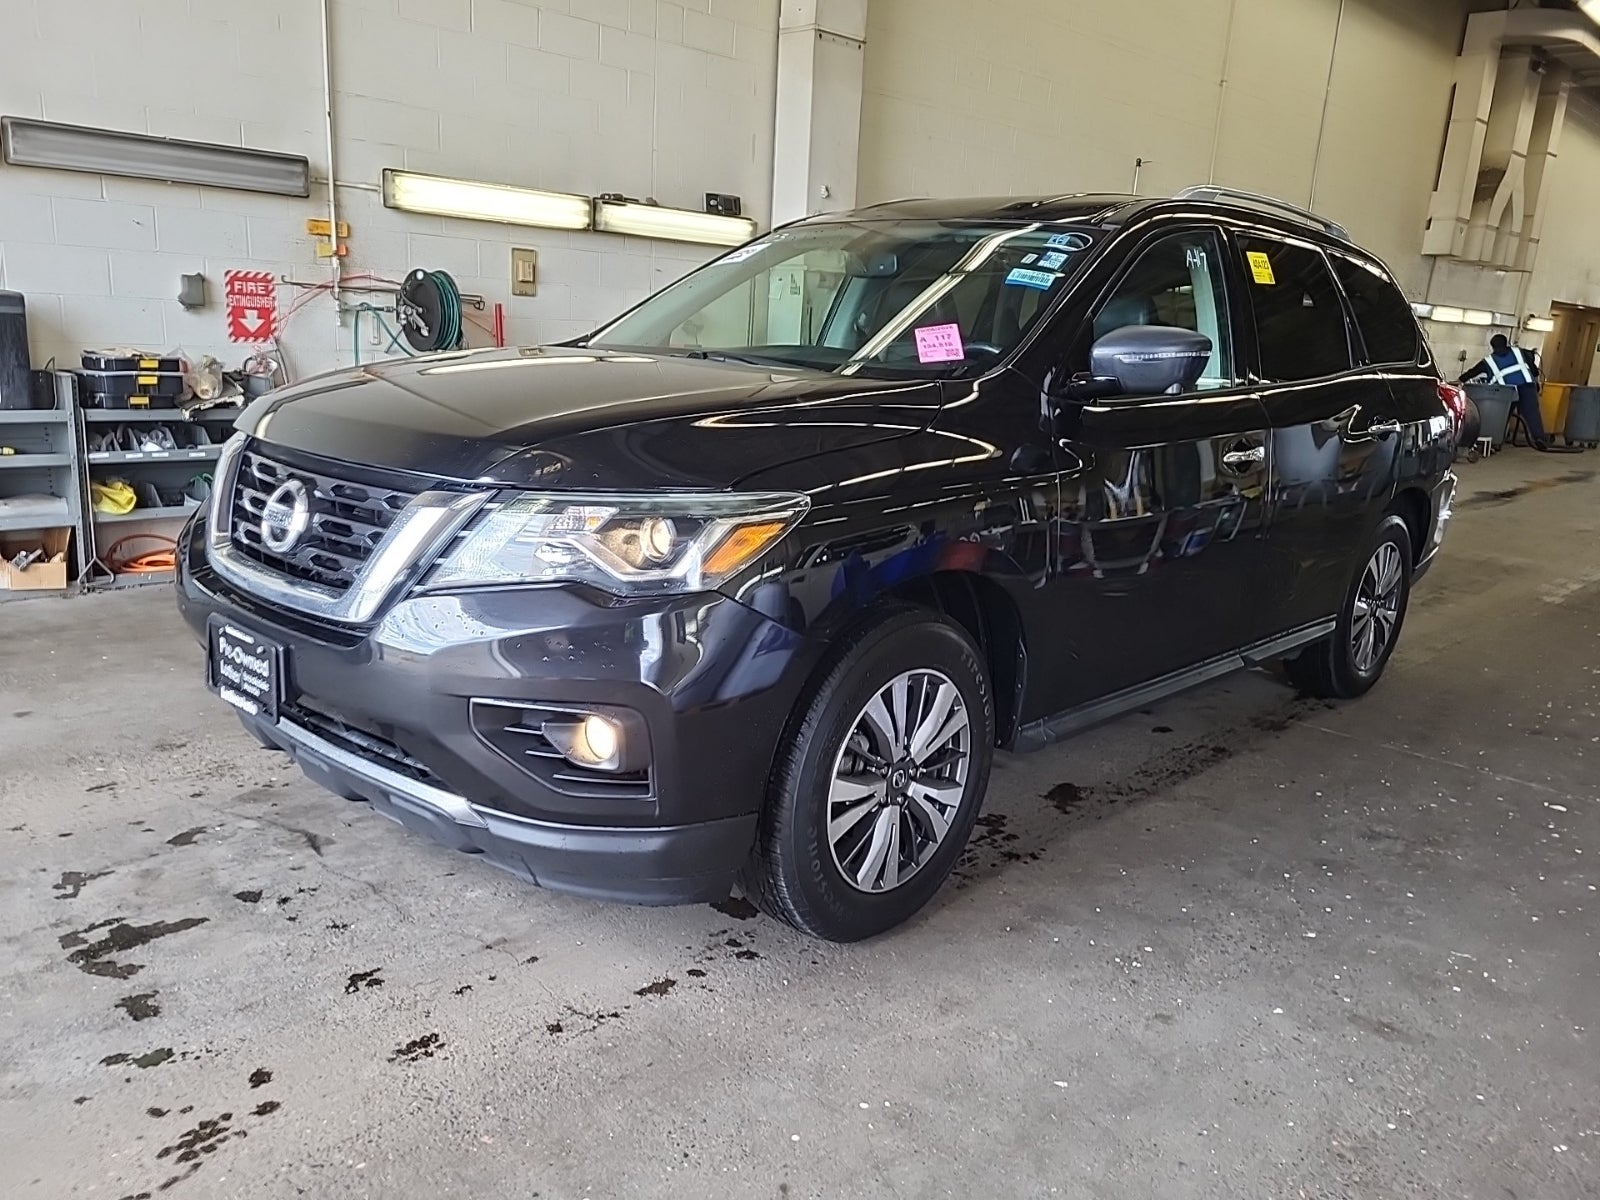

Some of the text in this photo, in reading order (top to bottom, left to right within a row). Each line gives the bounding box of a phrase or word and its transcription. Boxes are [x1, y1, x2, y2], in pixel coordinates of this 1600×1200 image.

[233, 280, 269, 294] FIRE
[229, 294, 275, 309] EXTINGUISHER
[934, 333, 952, 341] 117
[219, 635, 270, 678] Pre-Owned
